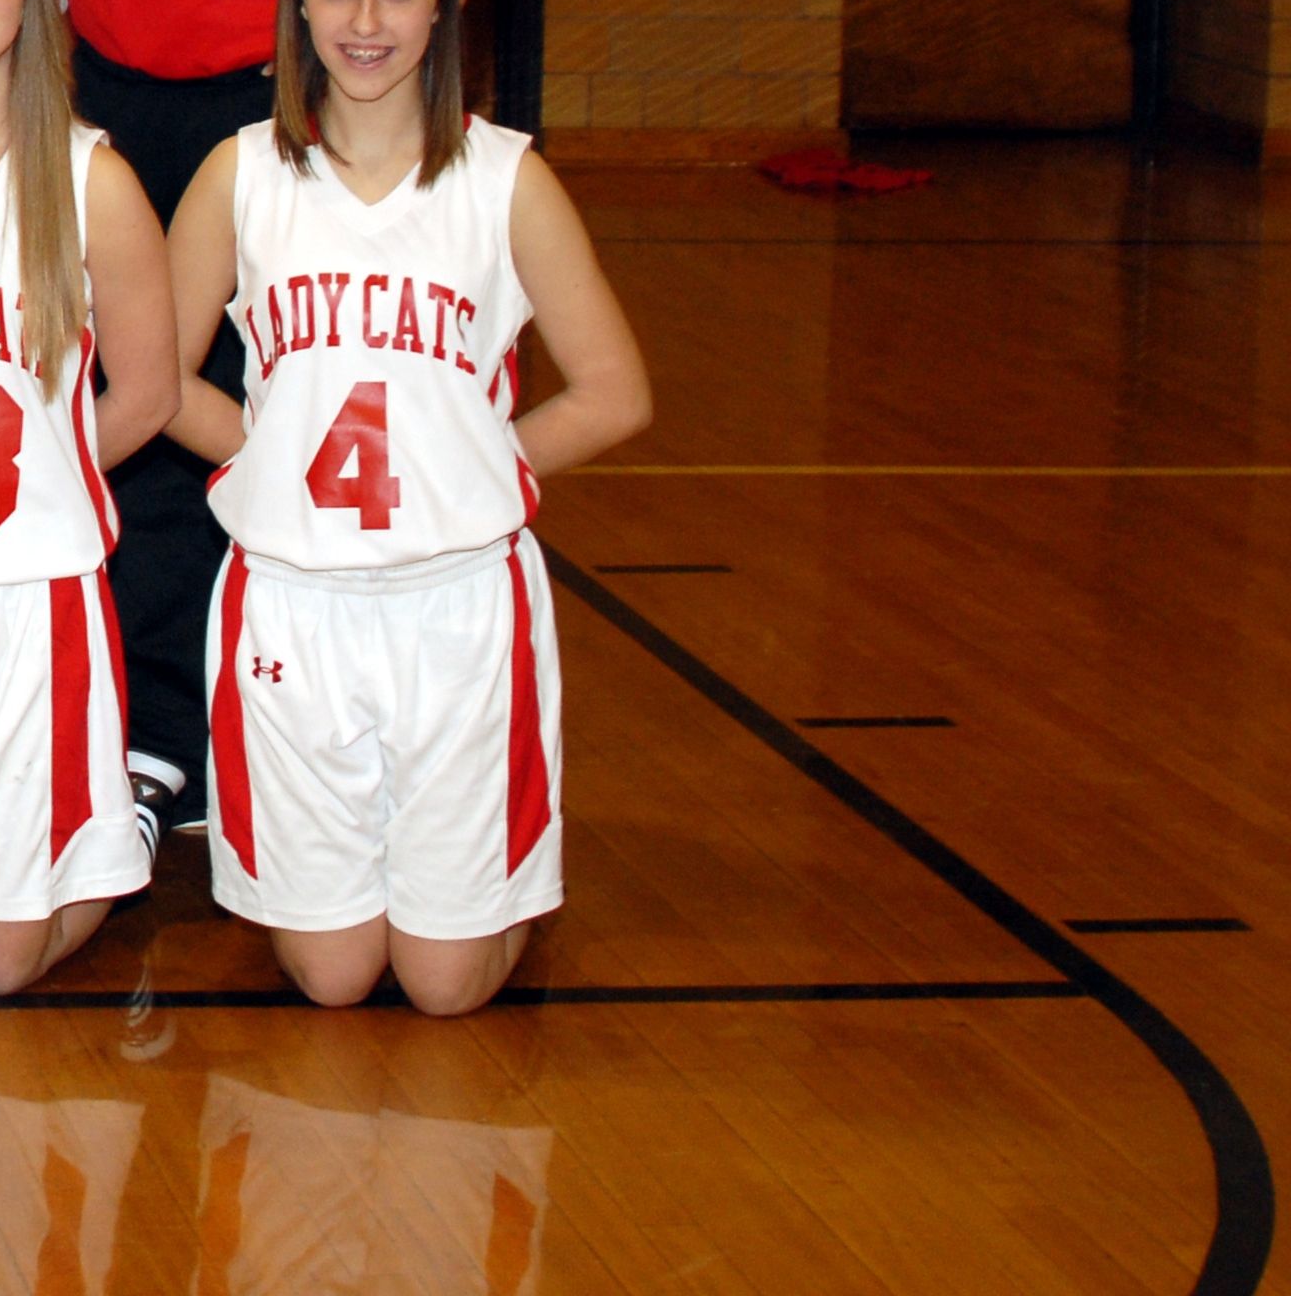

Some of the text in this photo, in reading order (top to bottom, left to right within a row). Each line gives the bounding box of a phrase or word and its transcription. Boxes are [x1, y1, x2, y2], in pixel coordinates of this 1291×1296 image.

[246, 273, 476, 381] LADY CATS
[305, 381, 400, 530] 4
